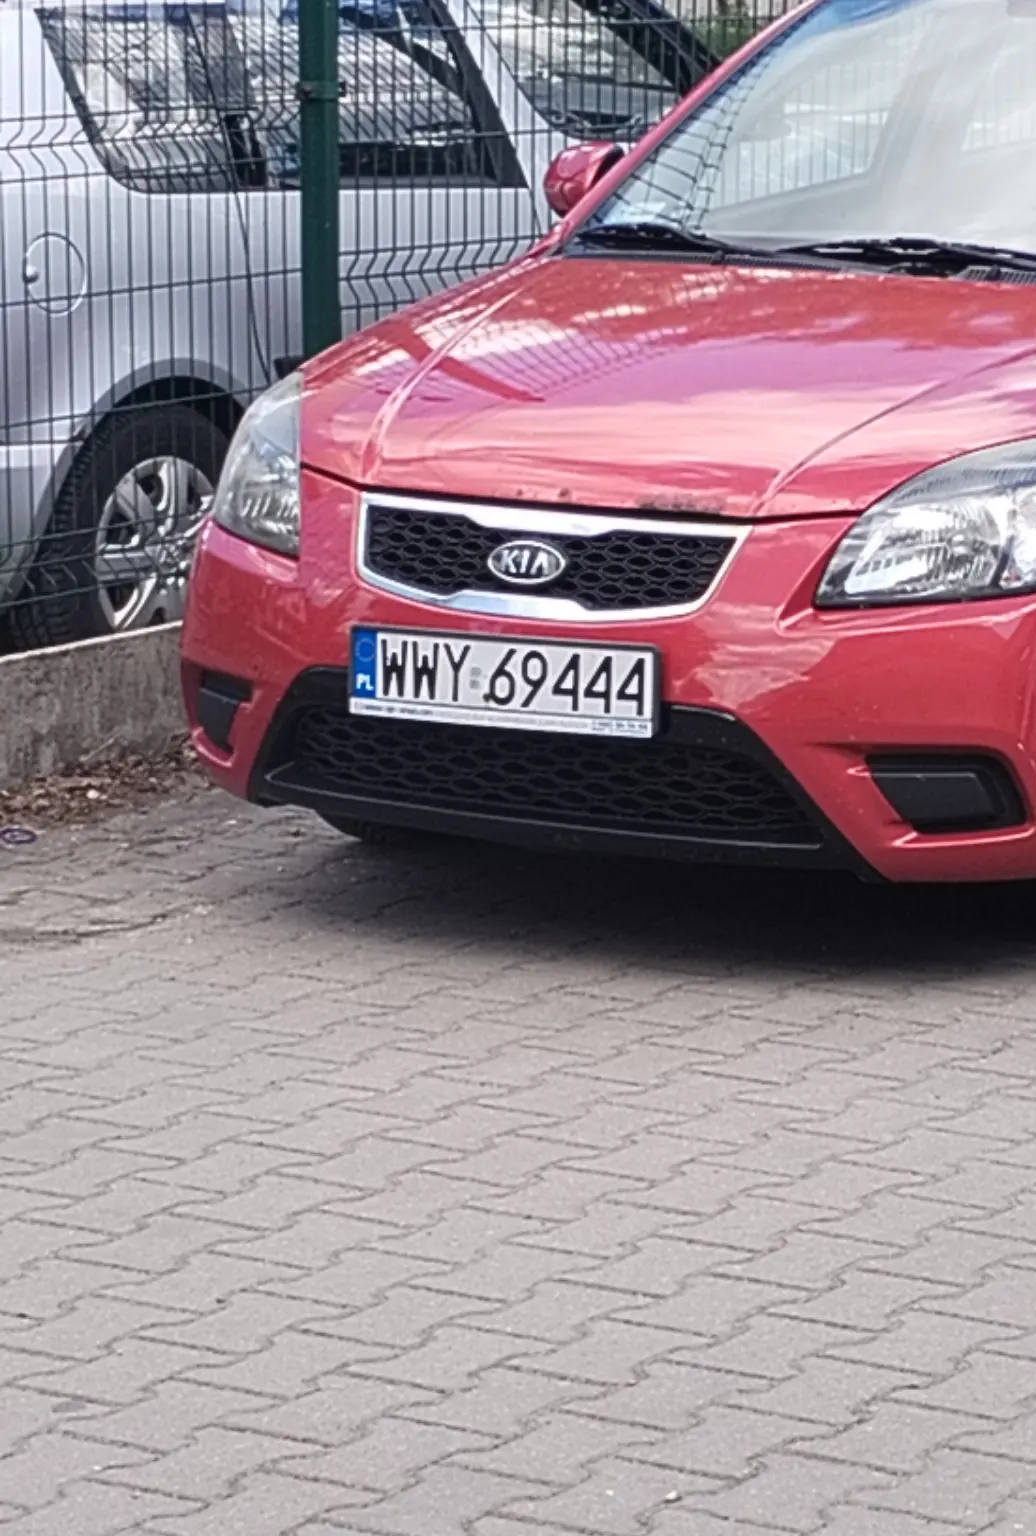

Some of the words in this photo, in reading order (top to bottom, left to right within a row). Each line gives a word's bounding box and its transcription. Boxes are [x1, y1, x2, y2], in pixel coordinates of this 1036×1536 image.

[501, 549, 549, 575] KIA
[356, 672, 374, 691] PL
[380, 638, 471, 702] WWY
[485, 648, 645, 717] 69444
